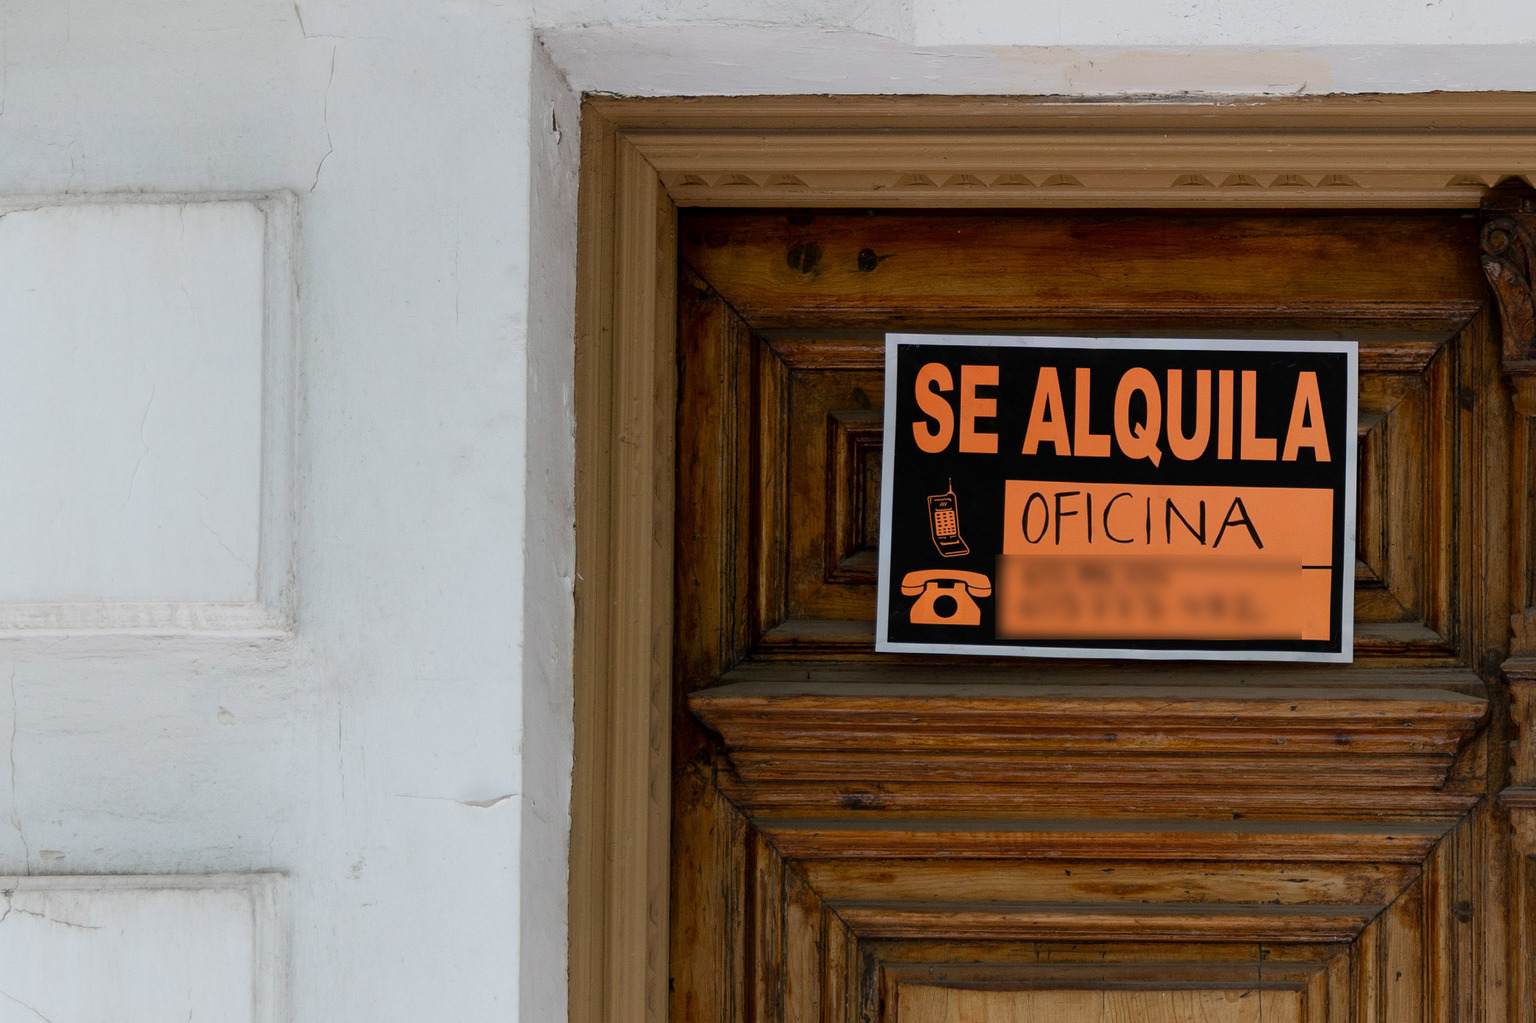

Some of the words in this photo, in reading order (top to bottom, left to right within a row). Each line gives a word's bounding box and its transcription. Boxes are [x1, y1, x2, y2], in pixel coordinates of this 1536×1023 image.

[912, 362, 1000, 455] SE
[1021, 366, 1332, 468] ALQUILA
[1021, 490, 1264, 550] OFICINA
